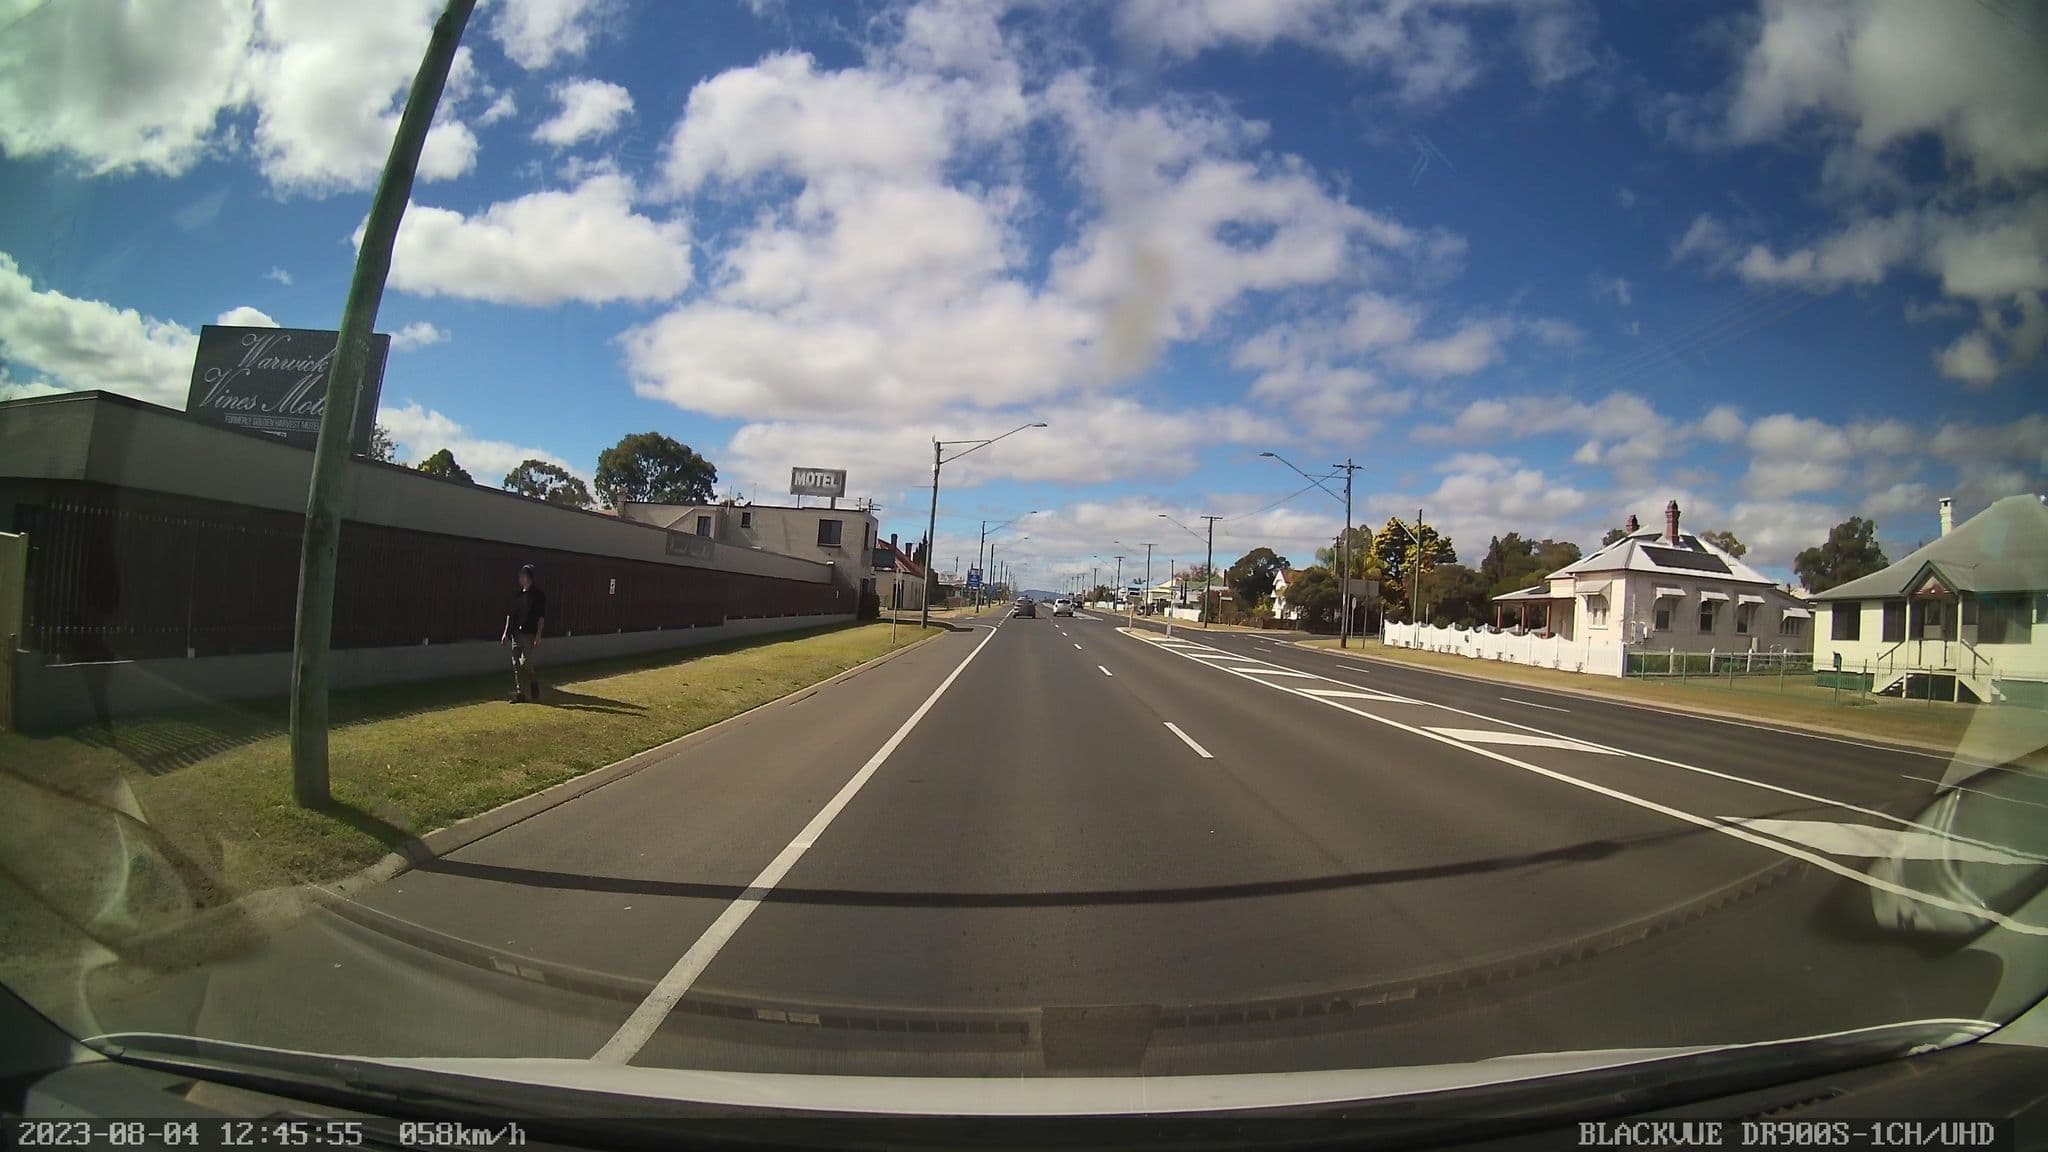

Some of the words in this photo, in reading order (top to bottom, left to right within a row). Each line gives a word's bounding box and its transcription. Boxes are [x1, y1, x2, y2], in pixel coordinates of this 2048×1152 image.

[238, 333, 337, 373] Warwick
[199, 367, 258, 410] Vines
[261, 373, 327, 415] Mot
[794, 471, 839, 487] MOTEL
